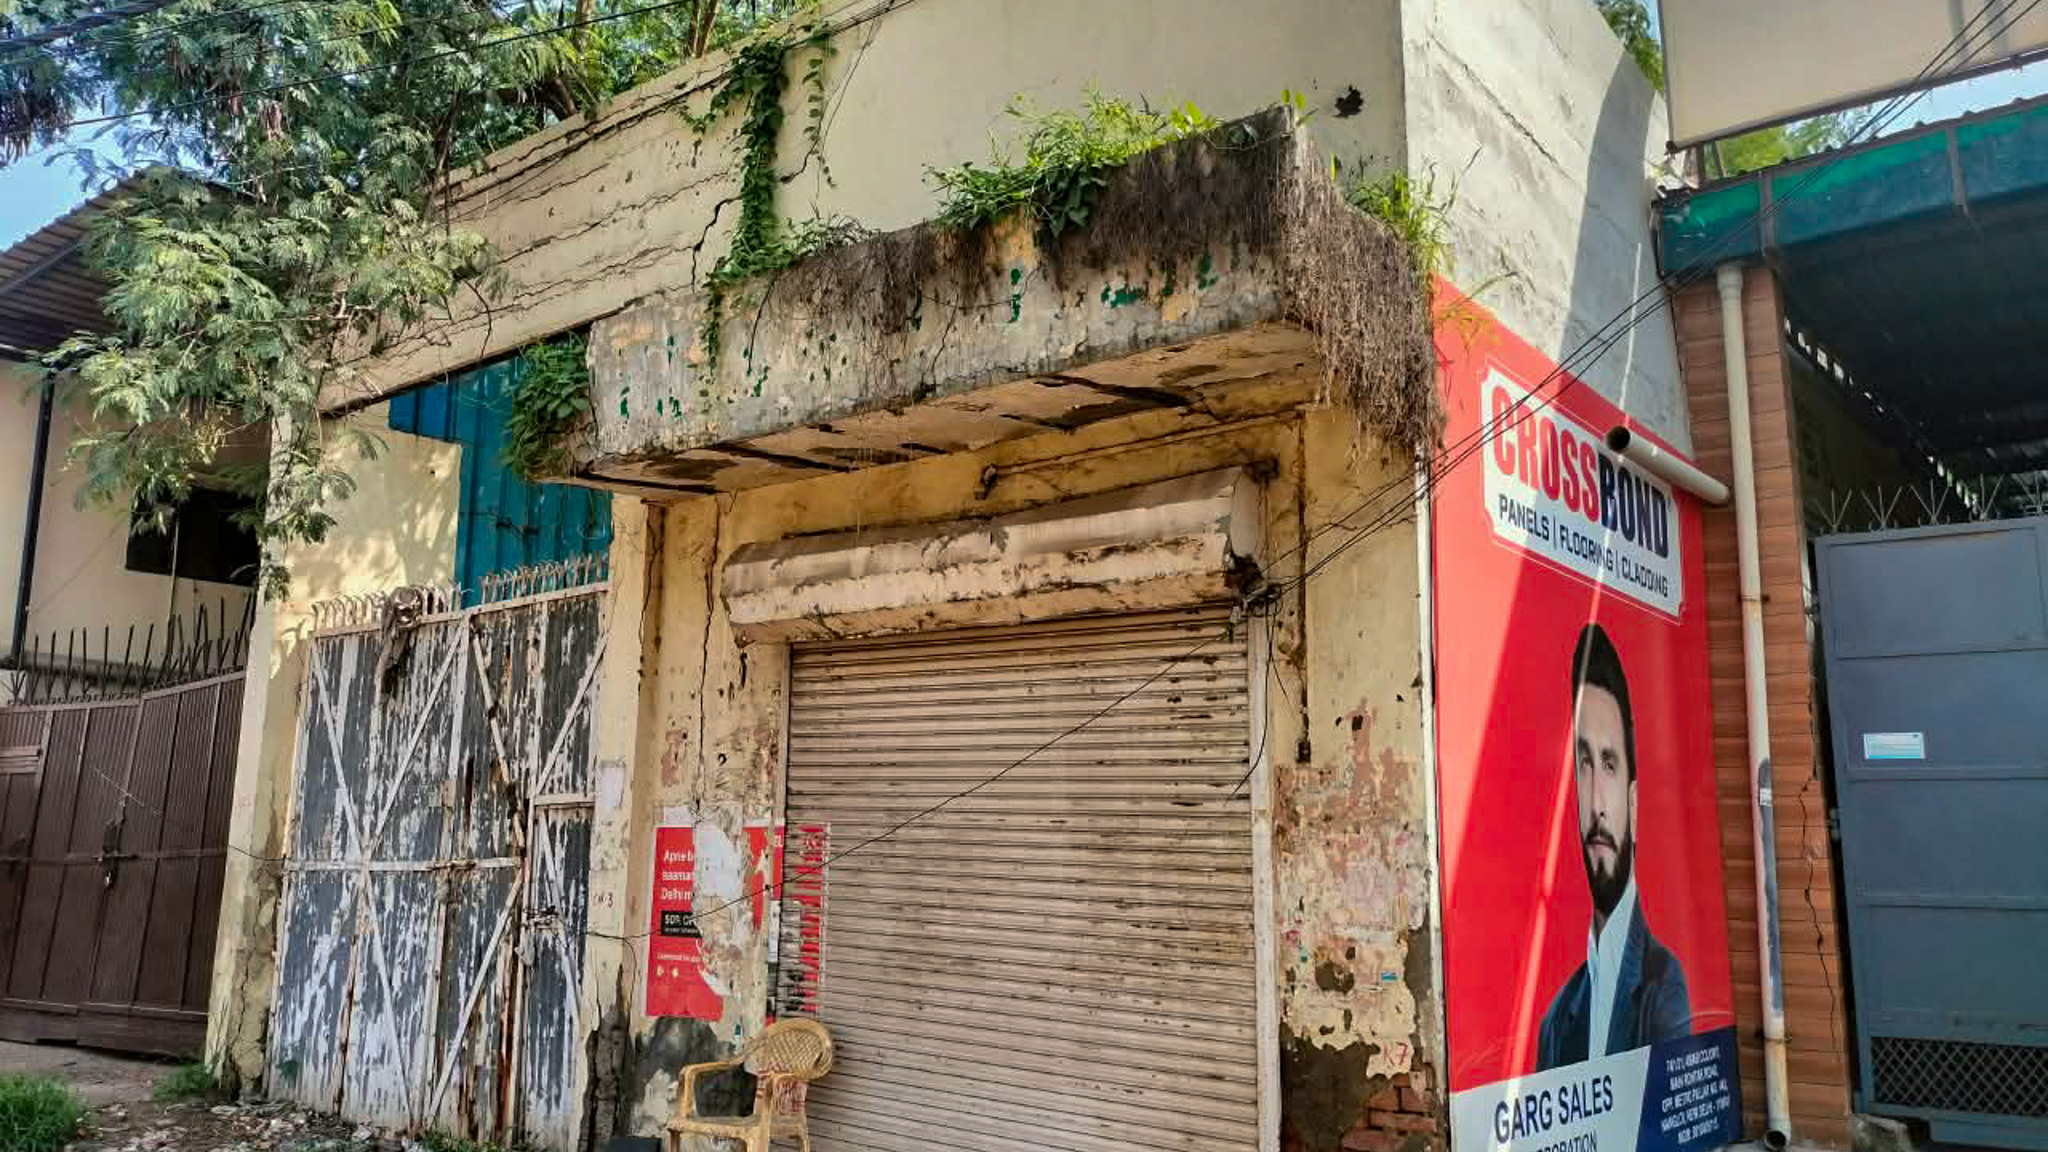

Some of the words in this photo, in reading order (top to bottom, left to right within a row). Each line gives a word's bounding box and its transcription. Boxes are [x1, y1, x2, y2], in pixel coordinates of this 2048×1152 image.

[1492, 386, 1669, 559] CROSSBOND
[1499, 493, 1550, 541] PANELS
[1560, 525, 1614, 572] FLOORING
[1621, 558, 1669, 598] CLADDING
[1495, 1090, 1553, 1144] GARG
[1558, 1075, 1613, 1125] SALES
